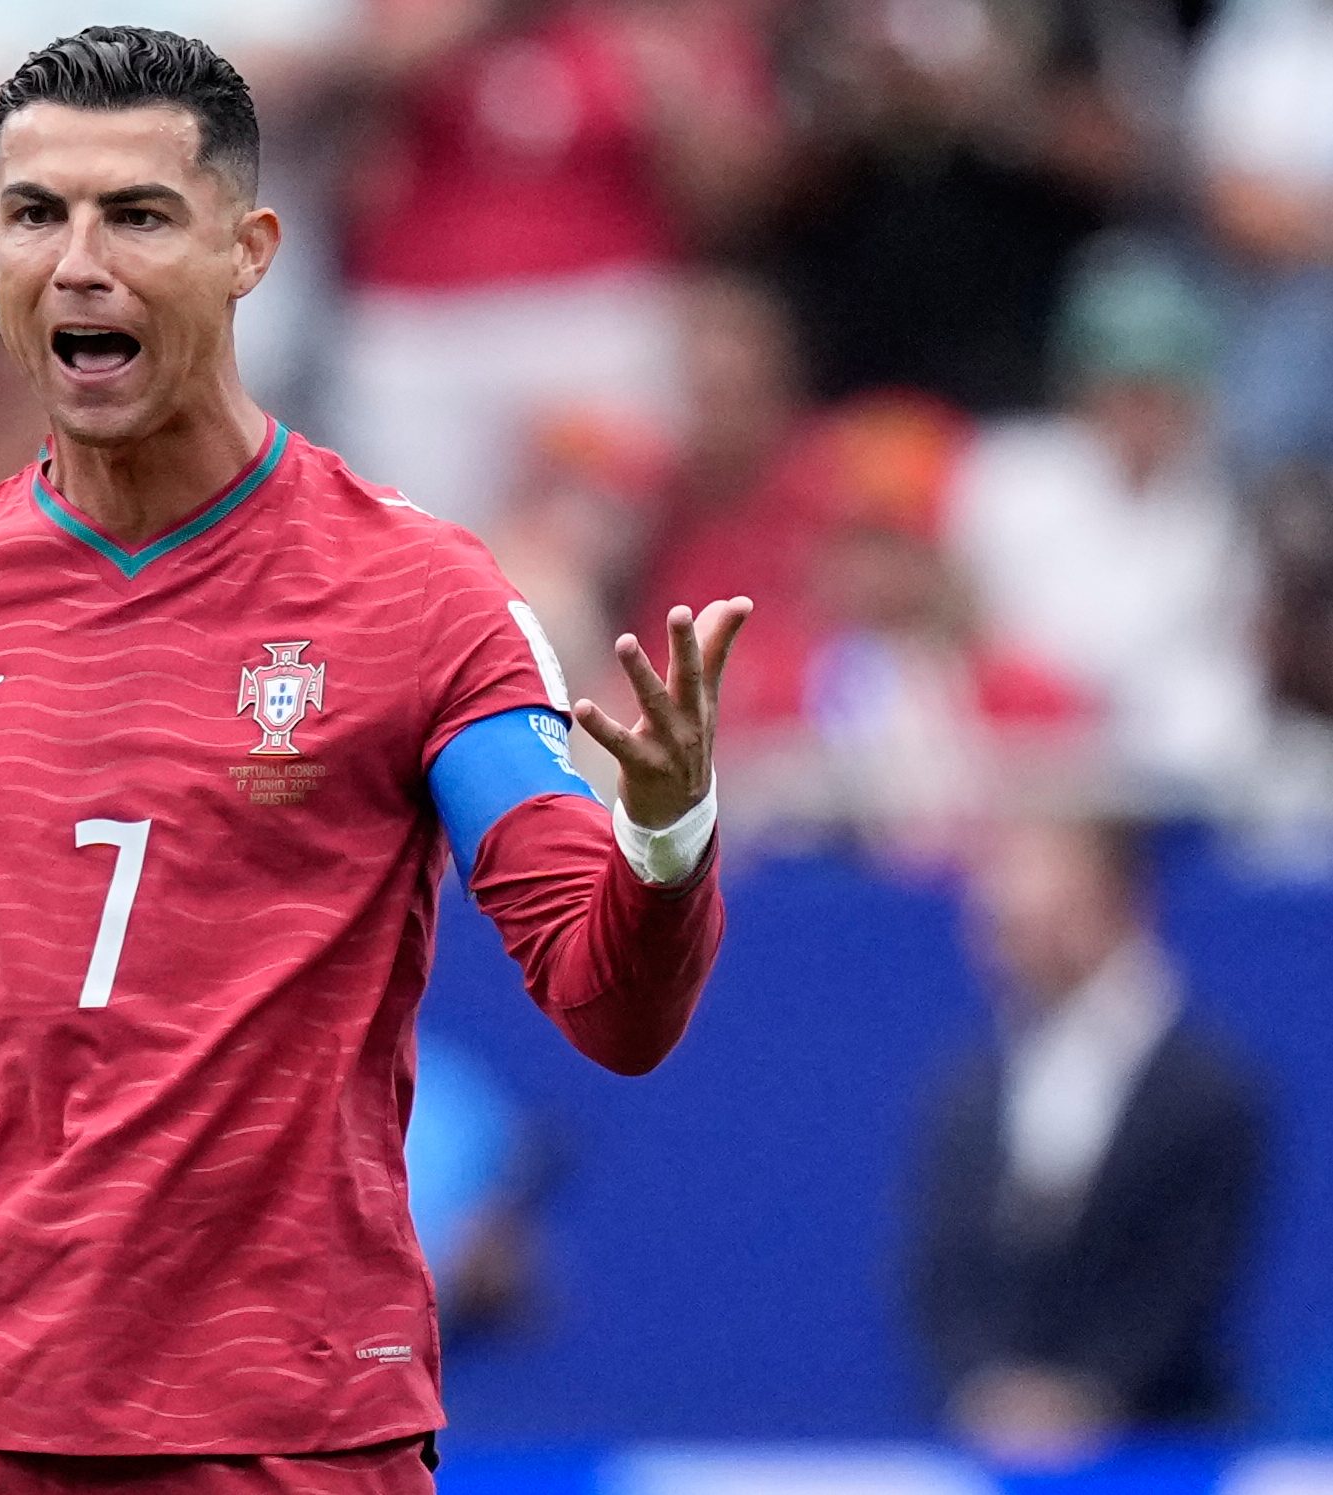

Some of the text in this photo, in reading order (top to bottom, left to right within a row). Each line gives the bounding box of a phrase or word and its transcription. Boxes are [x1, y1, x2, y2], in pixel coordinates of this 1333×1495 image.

[236, 779, 248, 792] 17
[250, 779, 286, 792] JUNHO
[249, 791, 306, 805] HOUSTON
[74, 818, 153, 1009] 7
